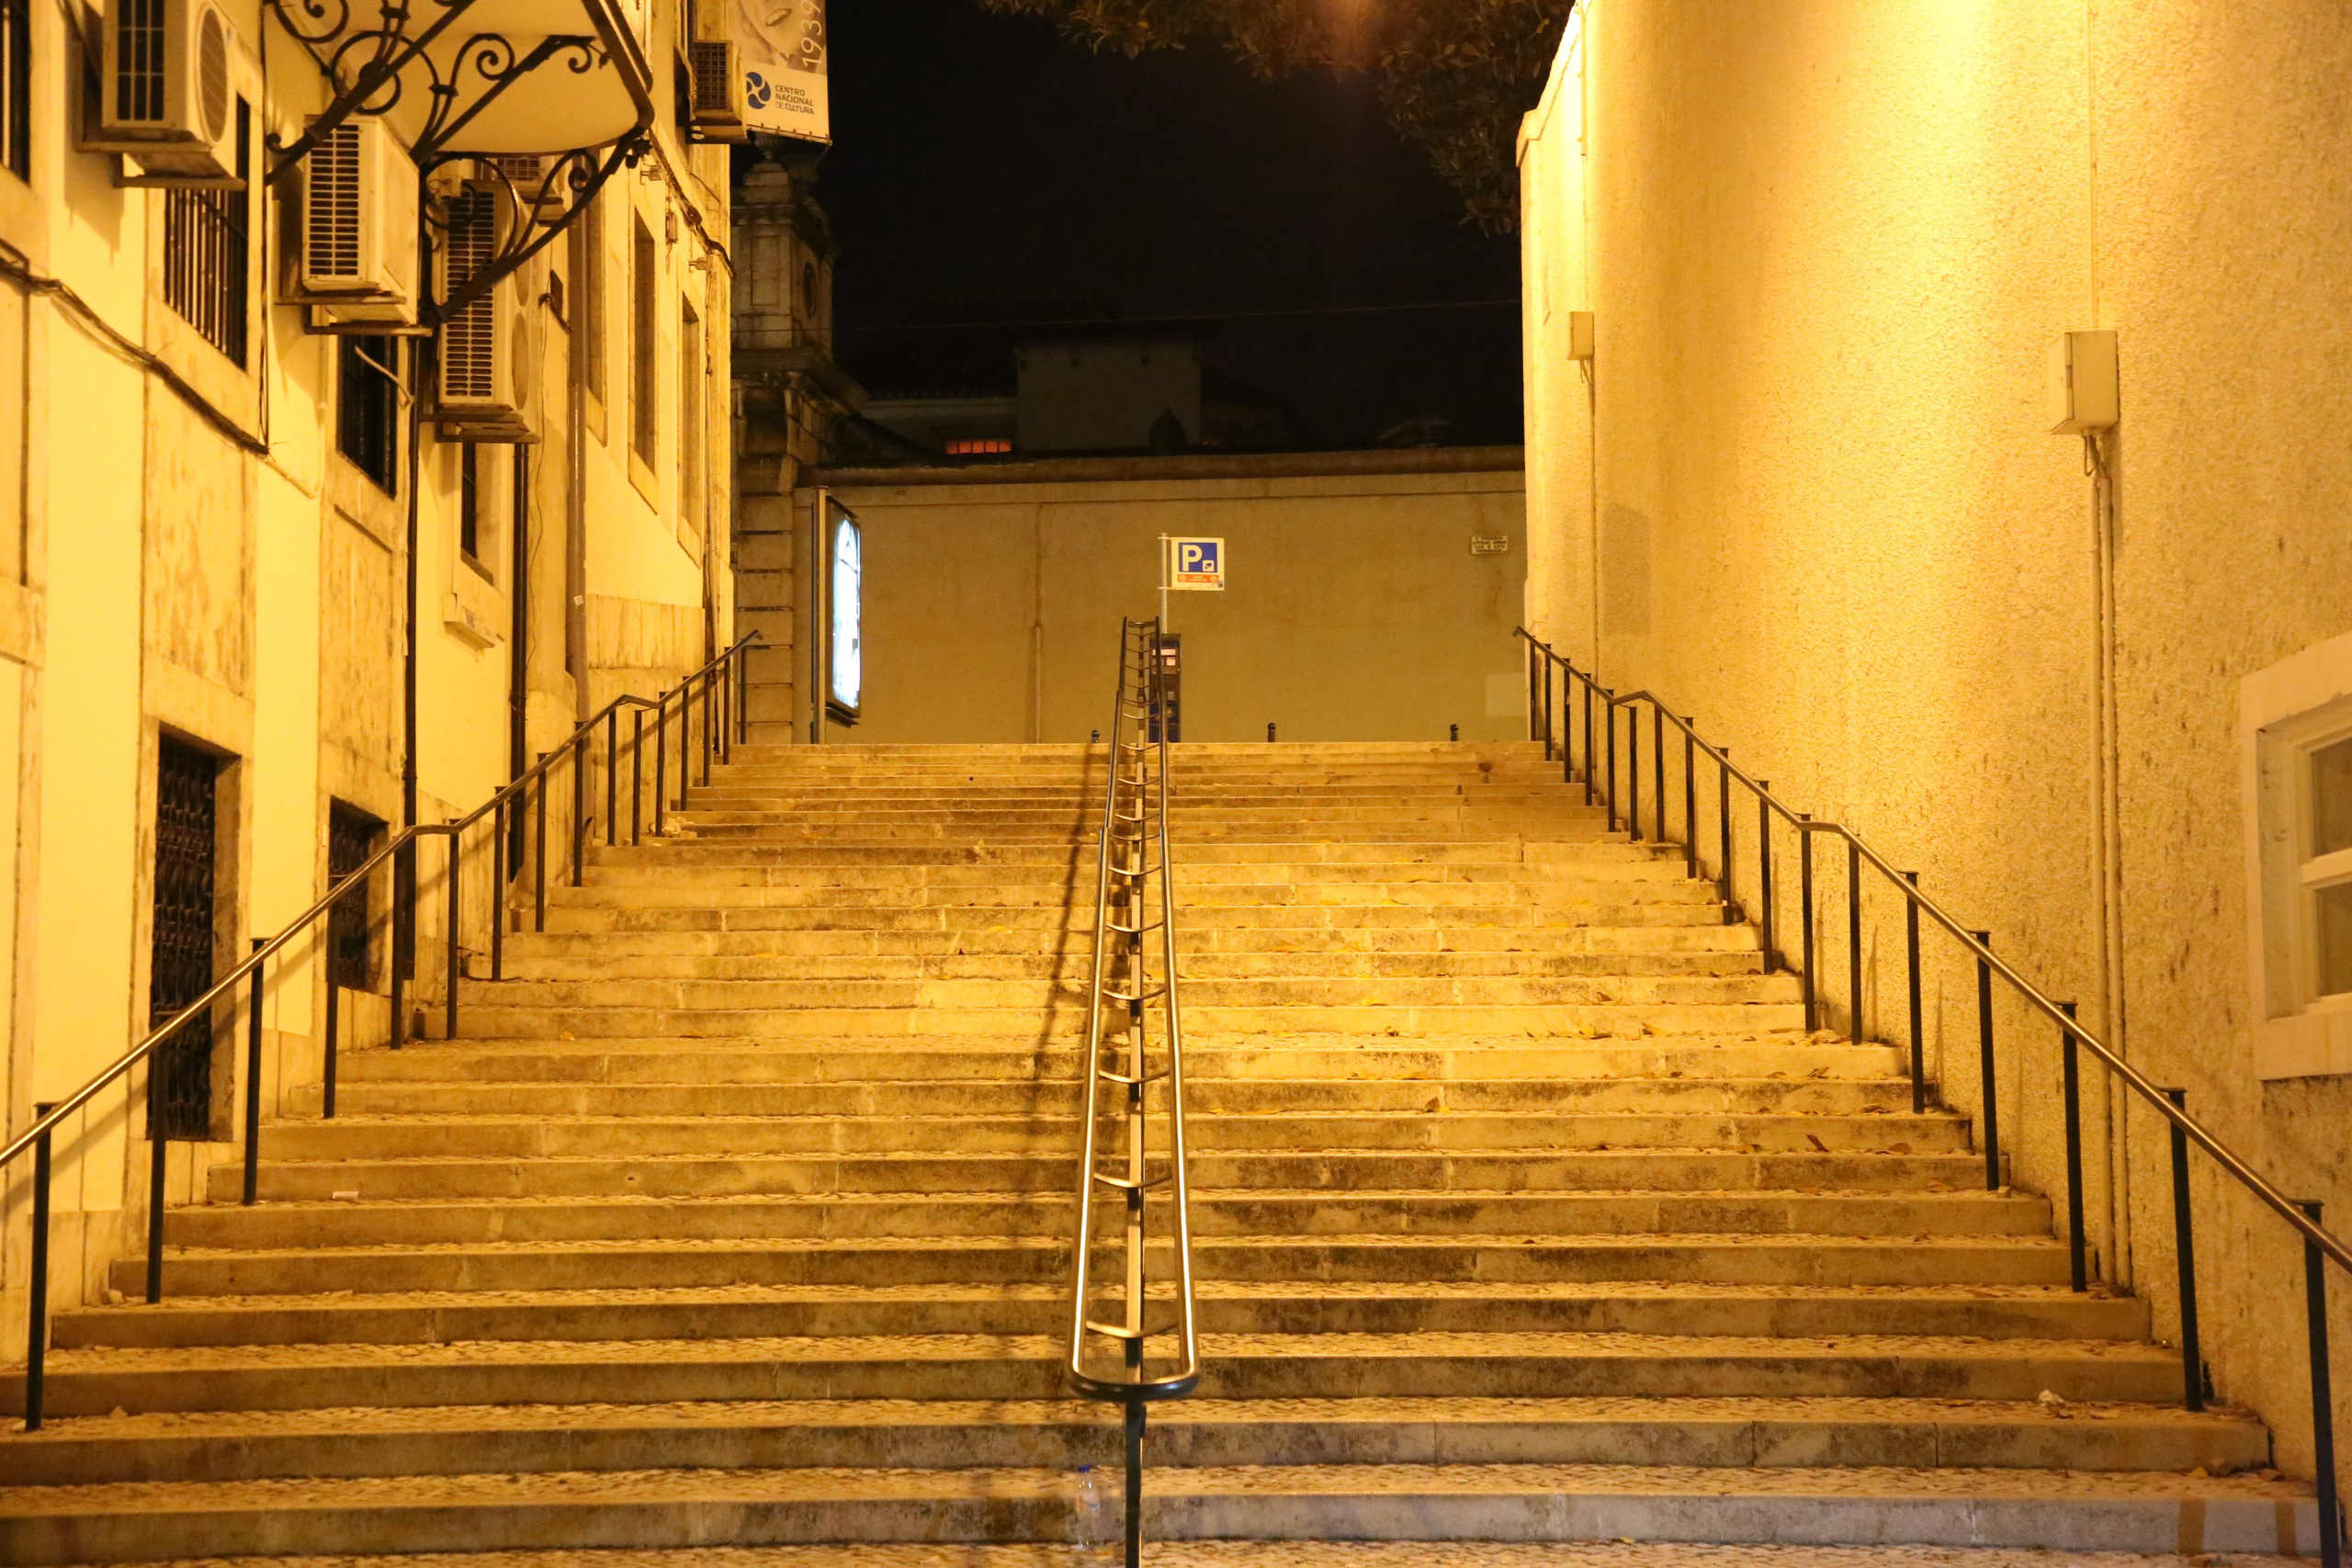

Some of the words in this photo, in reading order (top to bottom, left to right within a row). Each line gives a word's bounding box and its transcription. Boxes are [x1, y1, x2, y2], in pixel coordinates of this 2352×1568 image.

[800, 0, 822, 67] 1939
[775, 85, 806, 96] CENTRO
[775, 93, 814, 107] NACIONAL
[775, 101, 785, 109] DE
[785, 103, 815, 115] CULTURA
[1182, 544, 1203, 571] P
